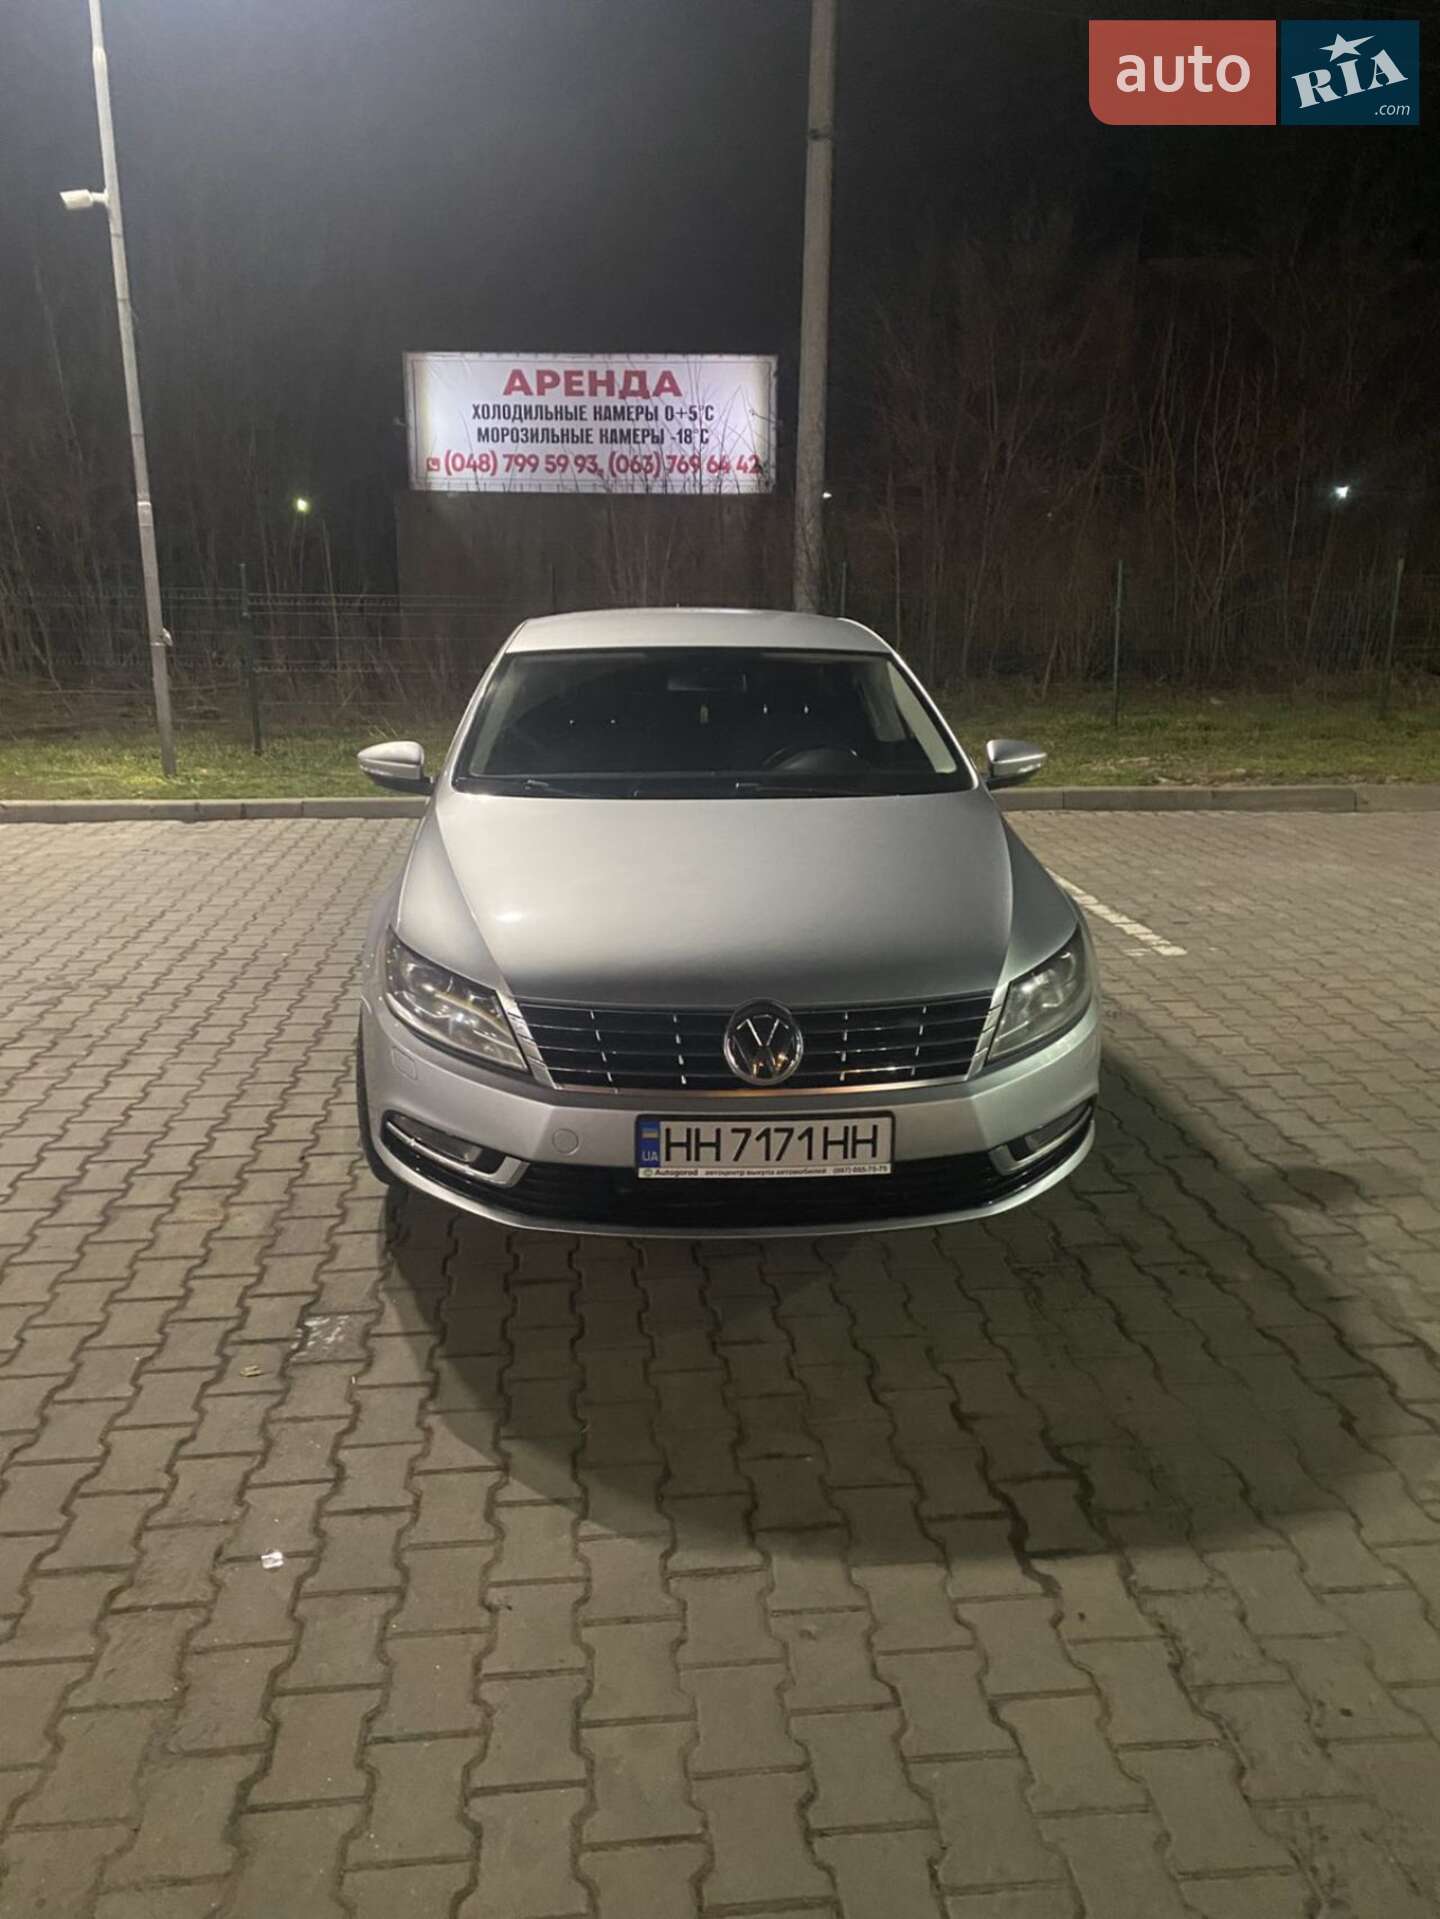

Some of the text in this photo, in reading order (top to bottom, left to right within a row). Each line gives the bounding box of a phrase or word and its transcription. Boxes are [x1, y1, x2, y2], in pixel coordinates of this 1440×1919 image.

[502, 368, 683, 399] АРЕНДА
[472, 403, 588, 423] ХОЛОДИЛЬНЫЕ
[476, 426, 594, 445] МОРОЗИЛЬНЫЕ
[444, 449, 498, 477] (048)
[502, 453, 540, 474] 799
[544, 454, 569, 474] 59
[608, 451, 661, 478] (063)
[665, 455, 701, 475] 769
[706, 455, 731, 475] 64
[735, 454, 761, 475] 42
[642, 1151, 659, 1163] UA
